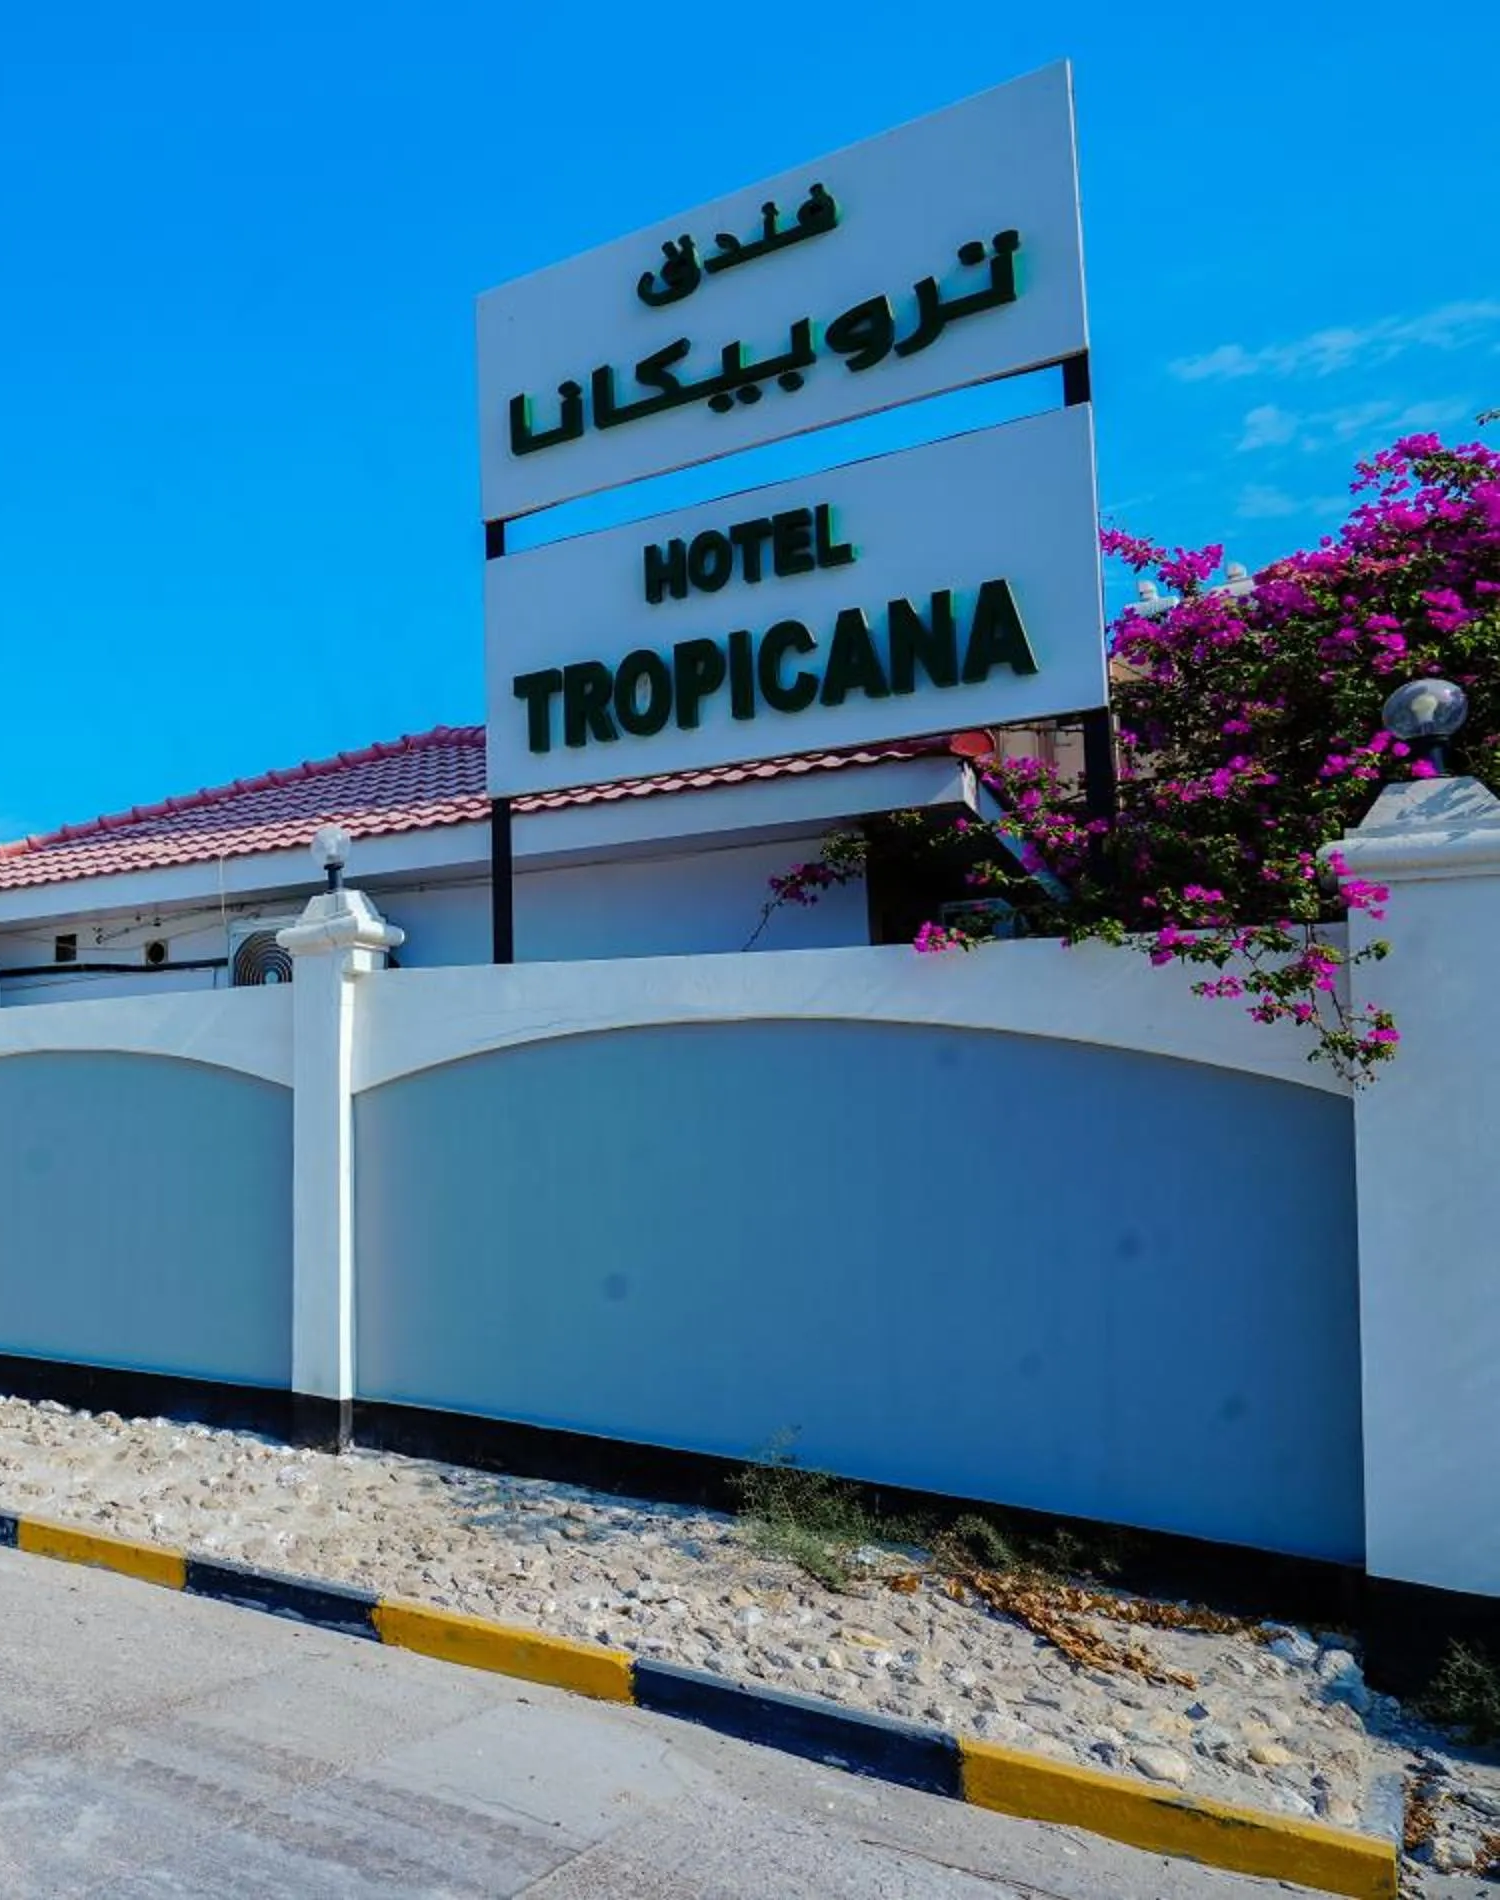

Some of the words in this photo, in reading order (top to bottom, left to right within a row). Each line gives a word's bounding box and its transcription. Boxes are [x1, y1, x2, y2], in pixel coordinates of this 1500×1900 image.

[637, 182, 841, 308] فندق
[509, 228, 1020, 457] تروبيكانا
[643, 503, 855, 604] HOTEL
[513, 578, 1039, 754] TROPICANA
